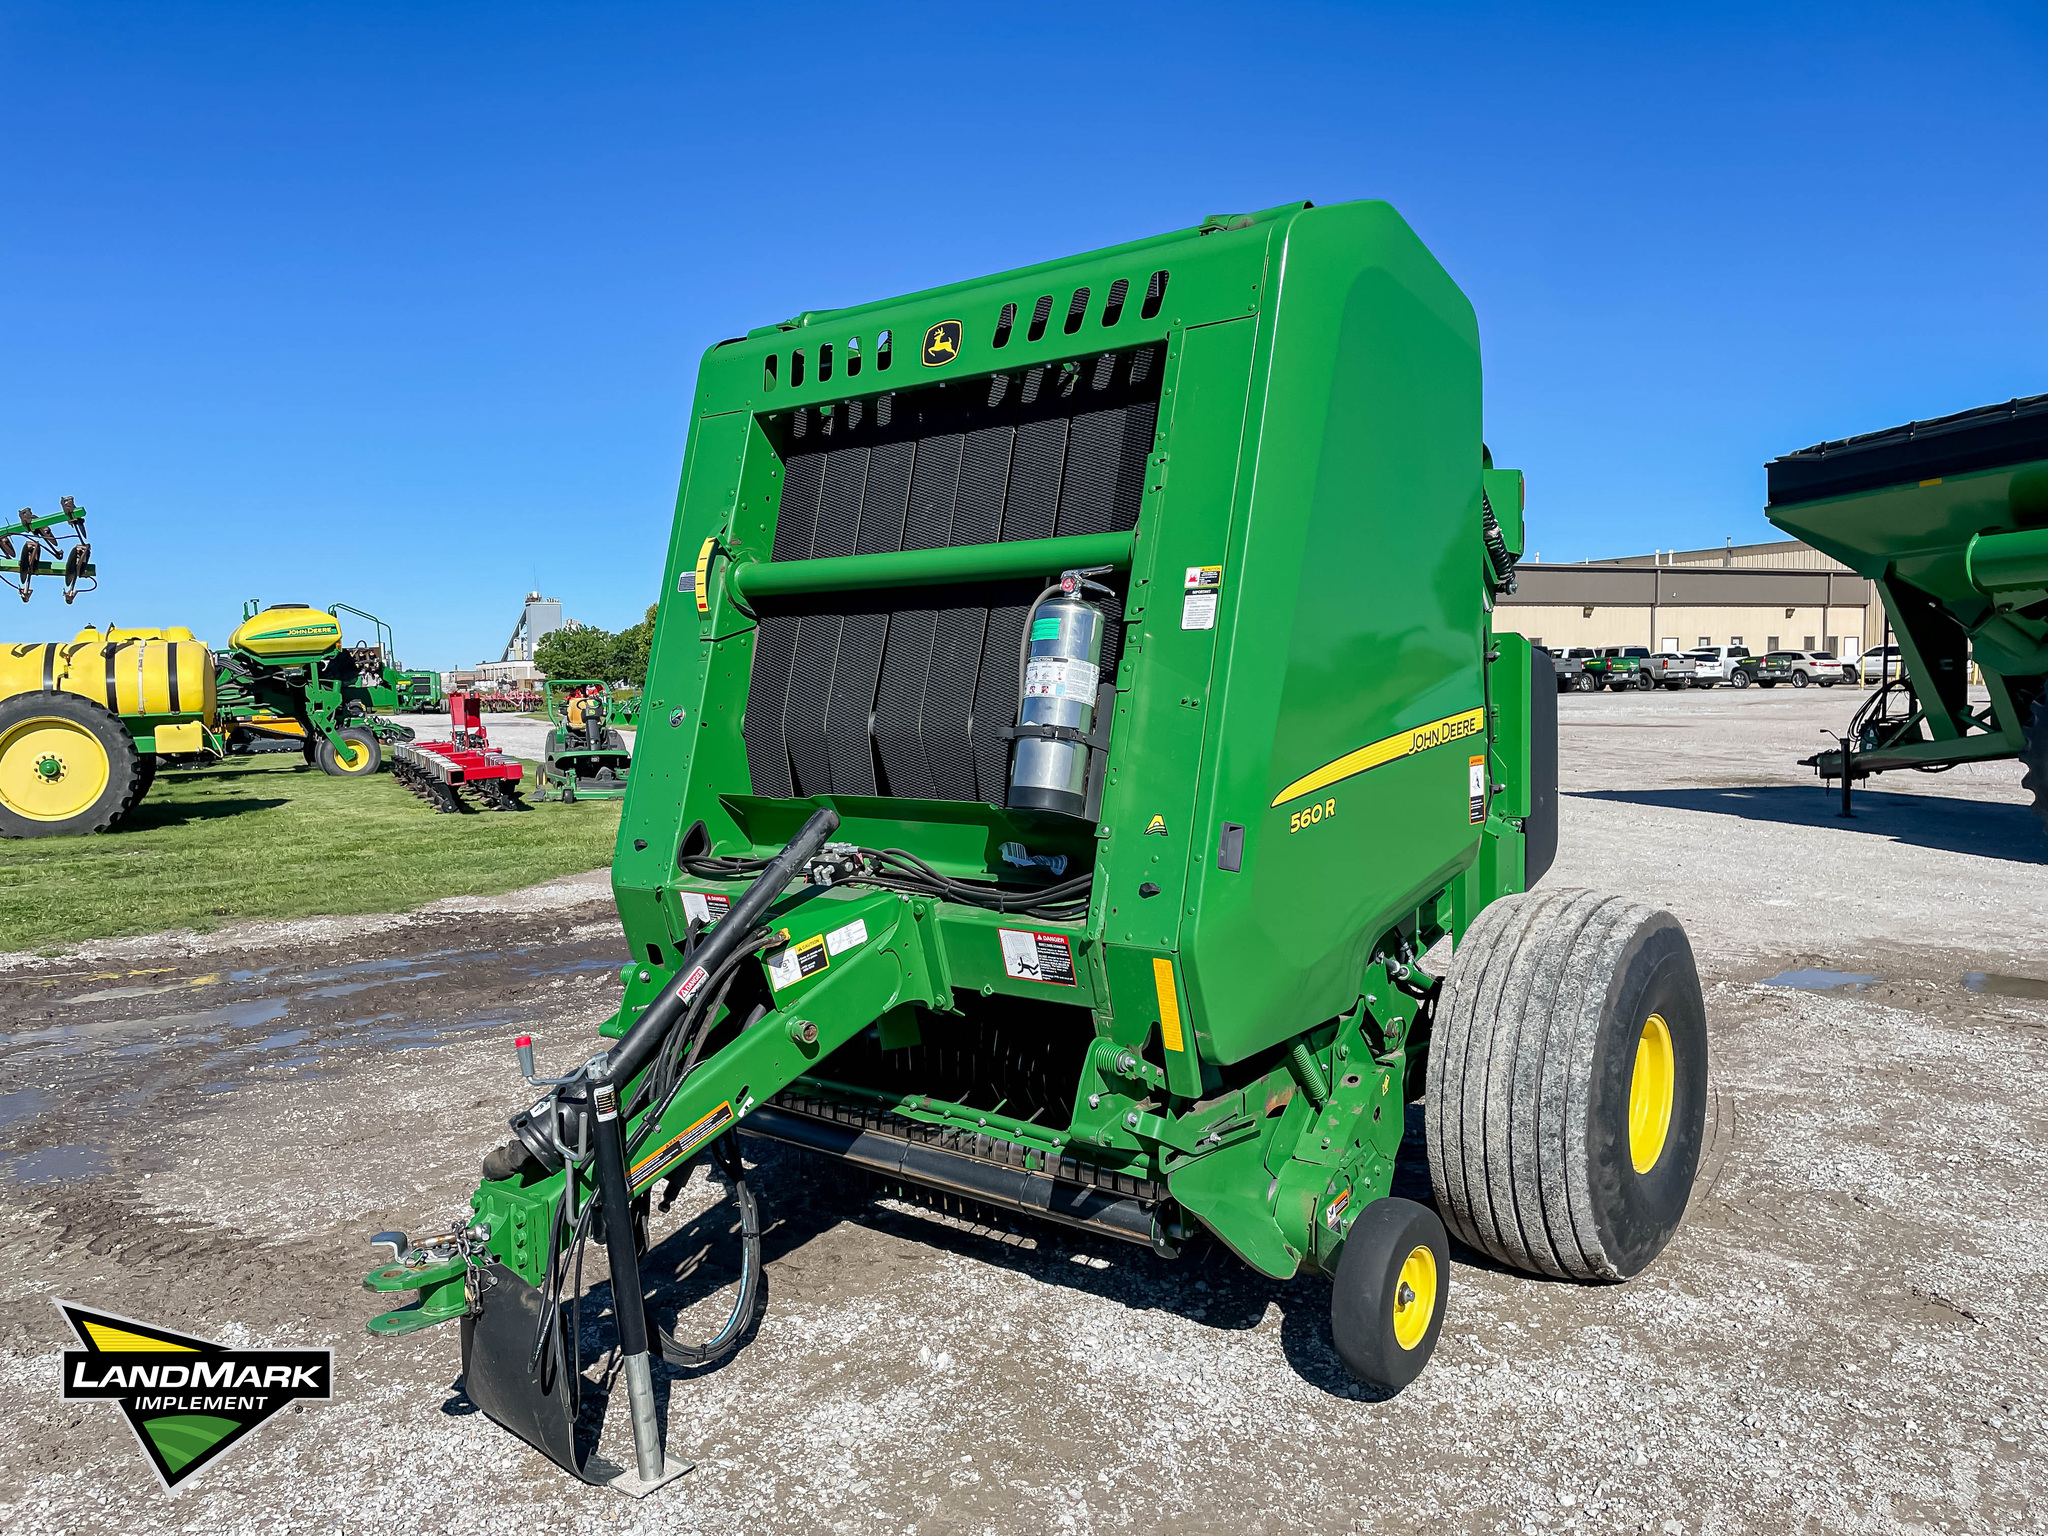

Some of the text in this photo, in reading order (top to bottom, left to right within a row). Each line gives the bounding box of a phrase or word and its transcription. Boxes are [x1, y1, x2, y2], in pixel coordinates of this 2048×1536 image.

[307, 627, 332, 635] DEERE
[1409, 717, 1476, 752] JOHN DEERE
[1290, 797, 1336, 834] 560 R
[802, 938, 820, 950] CAUTION
[1043, 935, 1065, 944] DANGER
[685, 968, 706, 992] DANGER
